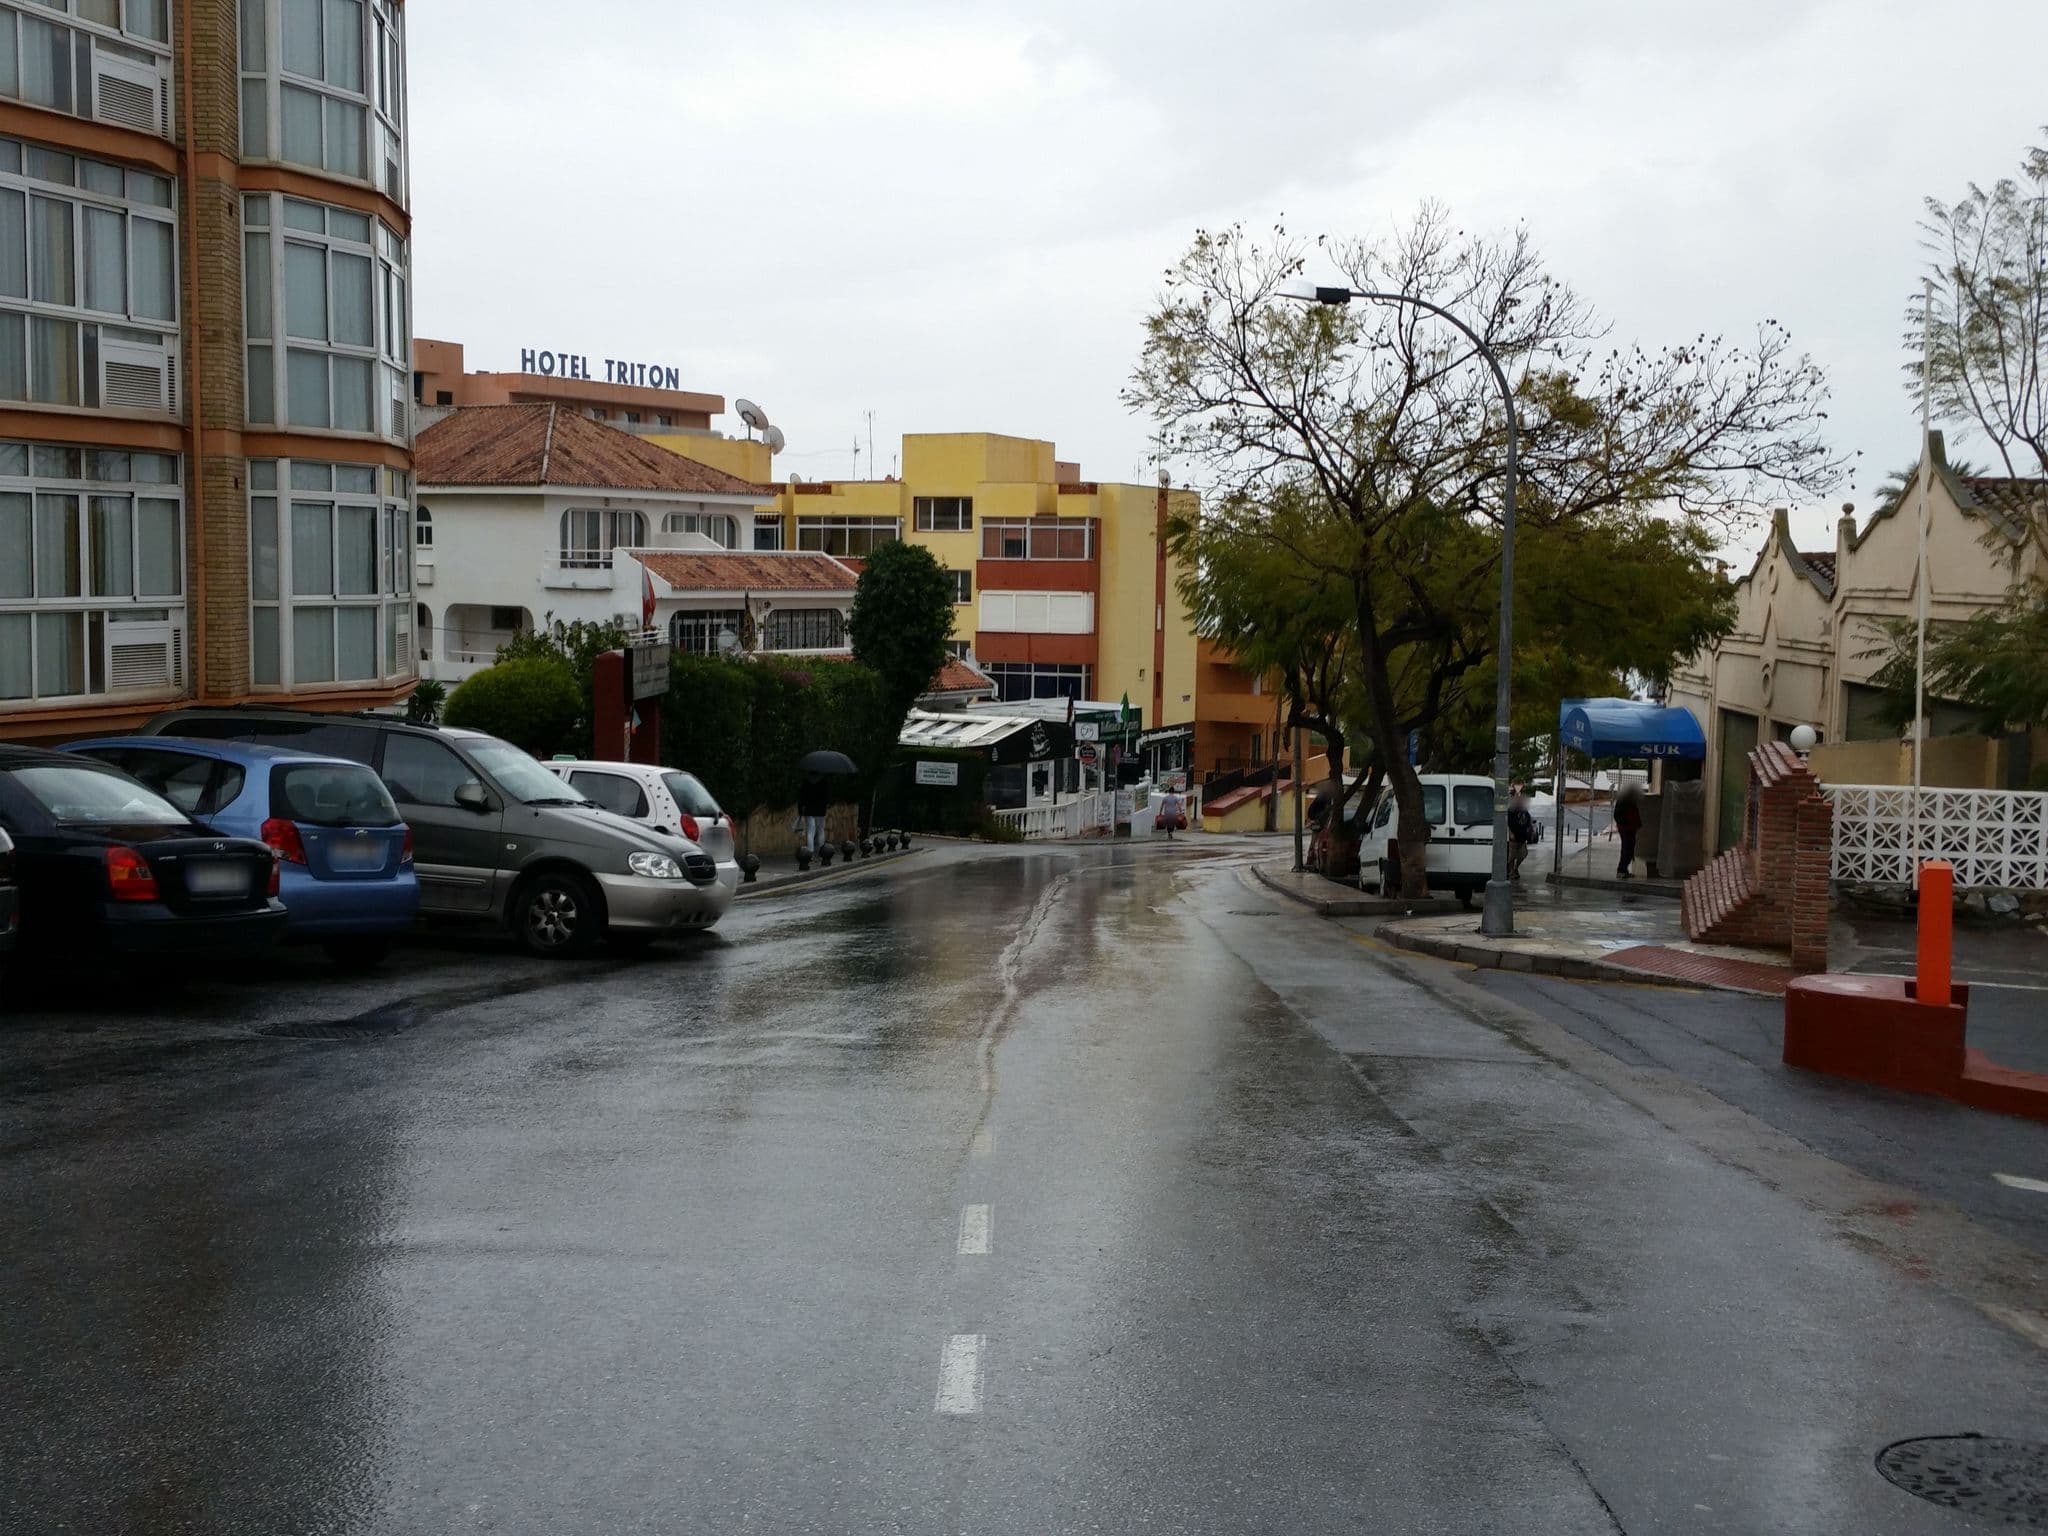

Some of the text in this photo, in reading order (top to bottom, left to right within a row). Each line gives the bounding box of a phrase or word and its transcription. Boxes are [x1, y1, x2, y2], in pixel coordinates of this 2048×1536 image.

[521, 348, 679, 389] HOTEL TRITON
[1640, 743, 1681, 755] SUR
